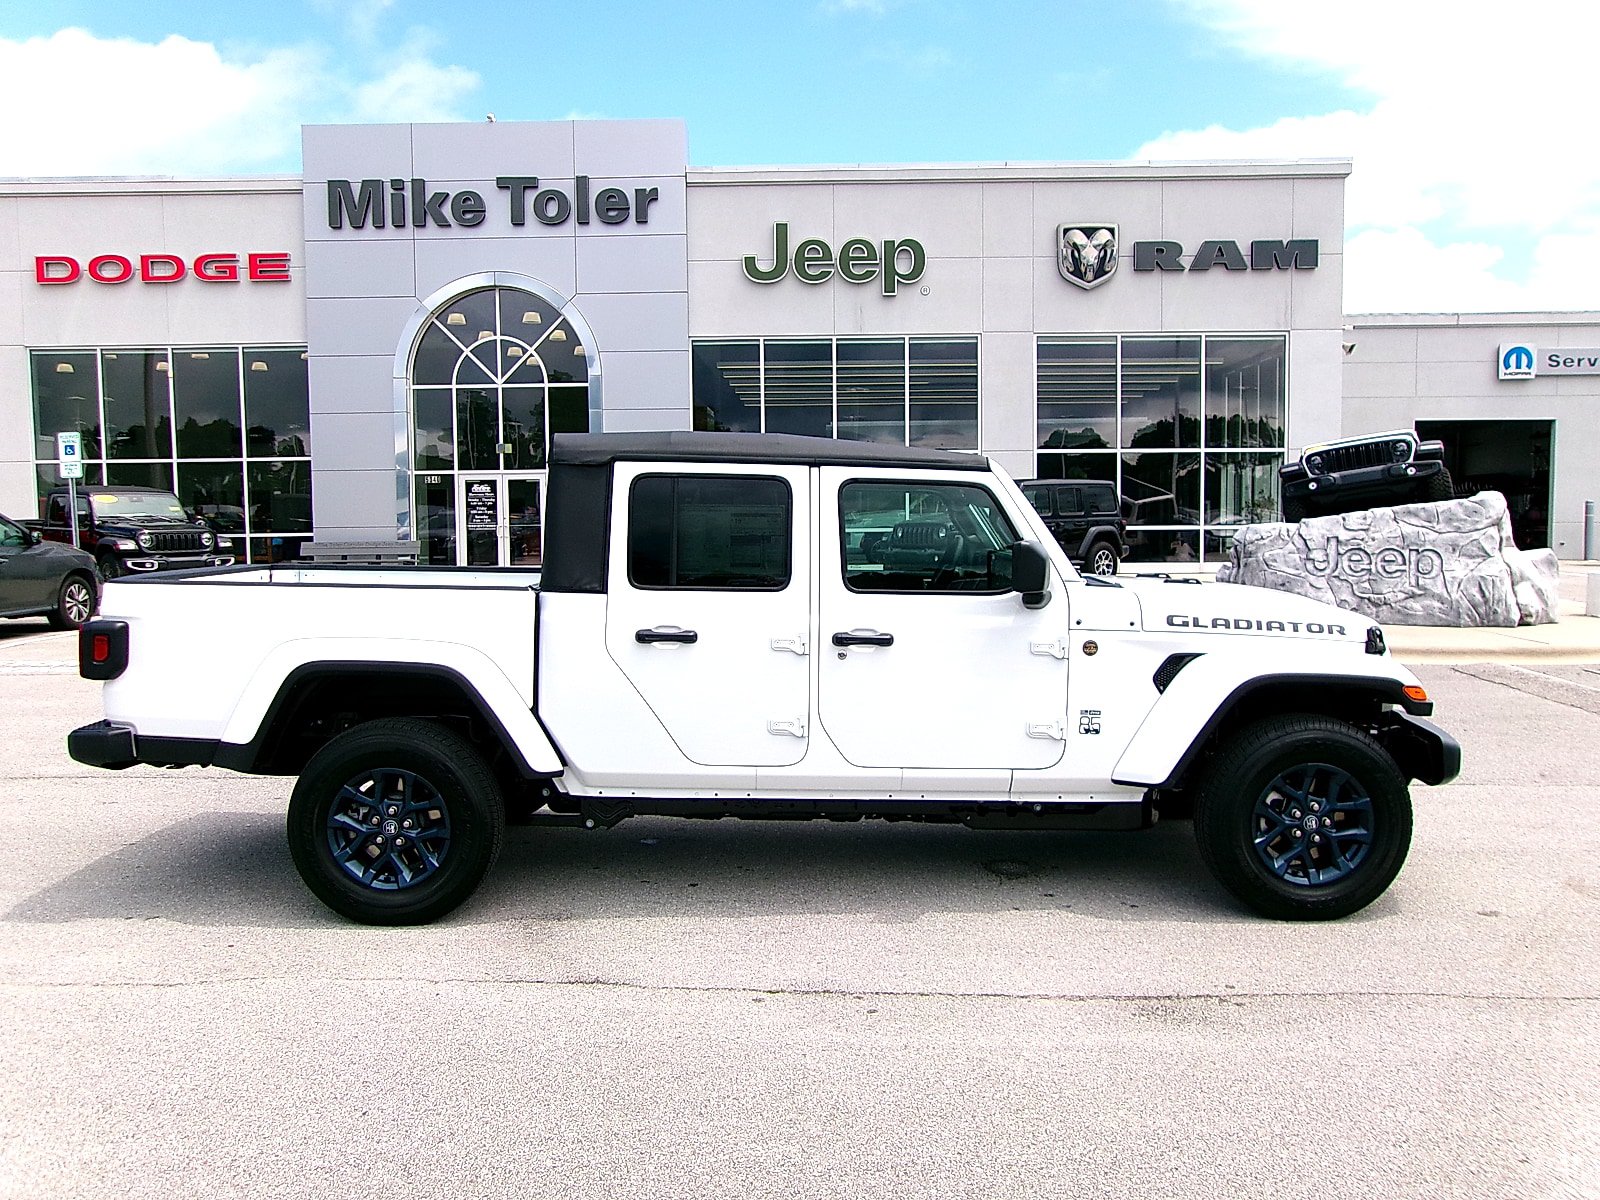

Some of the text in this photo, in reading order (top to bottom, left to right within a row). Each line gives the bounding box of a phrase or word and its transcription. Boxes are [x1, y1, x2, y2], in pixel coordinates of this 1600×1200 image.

[327, 175, 659, 229] Mike Toler
[34, 251, 292, 285] DODGE
[742, 221, 928, 297] Jeep
[1133, 238, 1320, 272] RAM
[1547, 353, 1599, 368] Serv
[1305, 536, 1444, 588] Jeep
[1166, 614, 1347, 636] GLADIATOR
